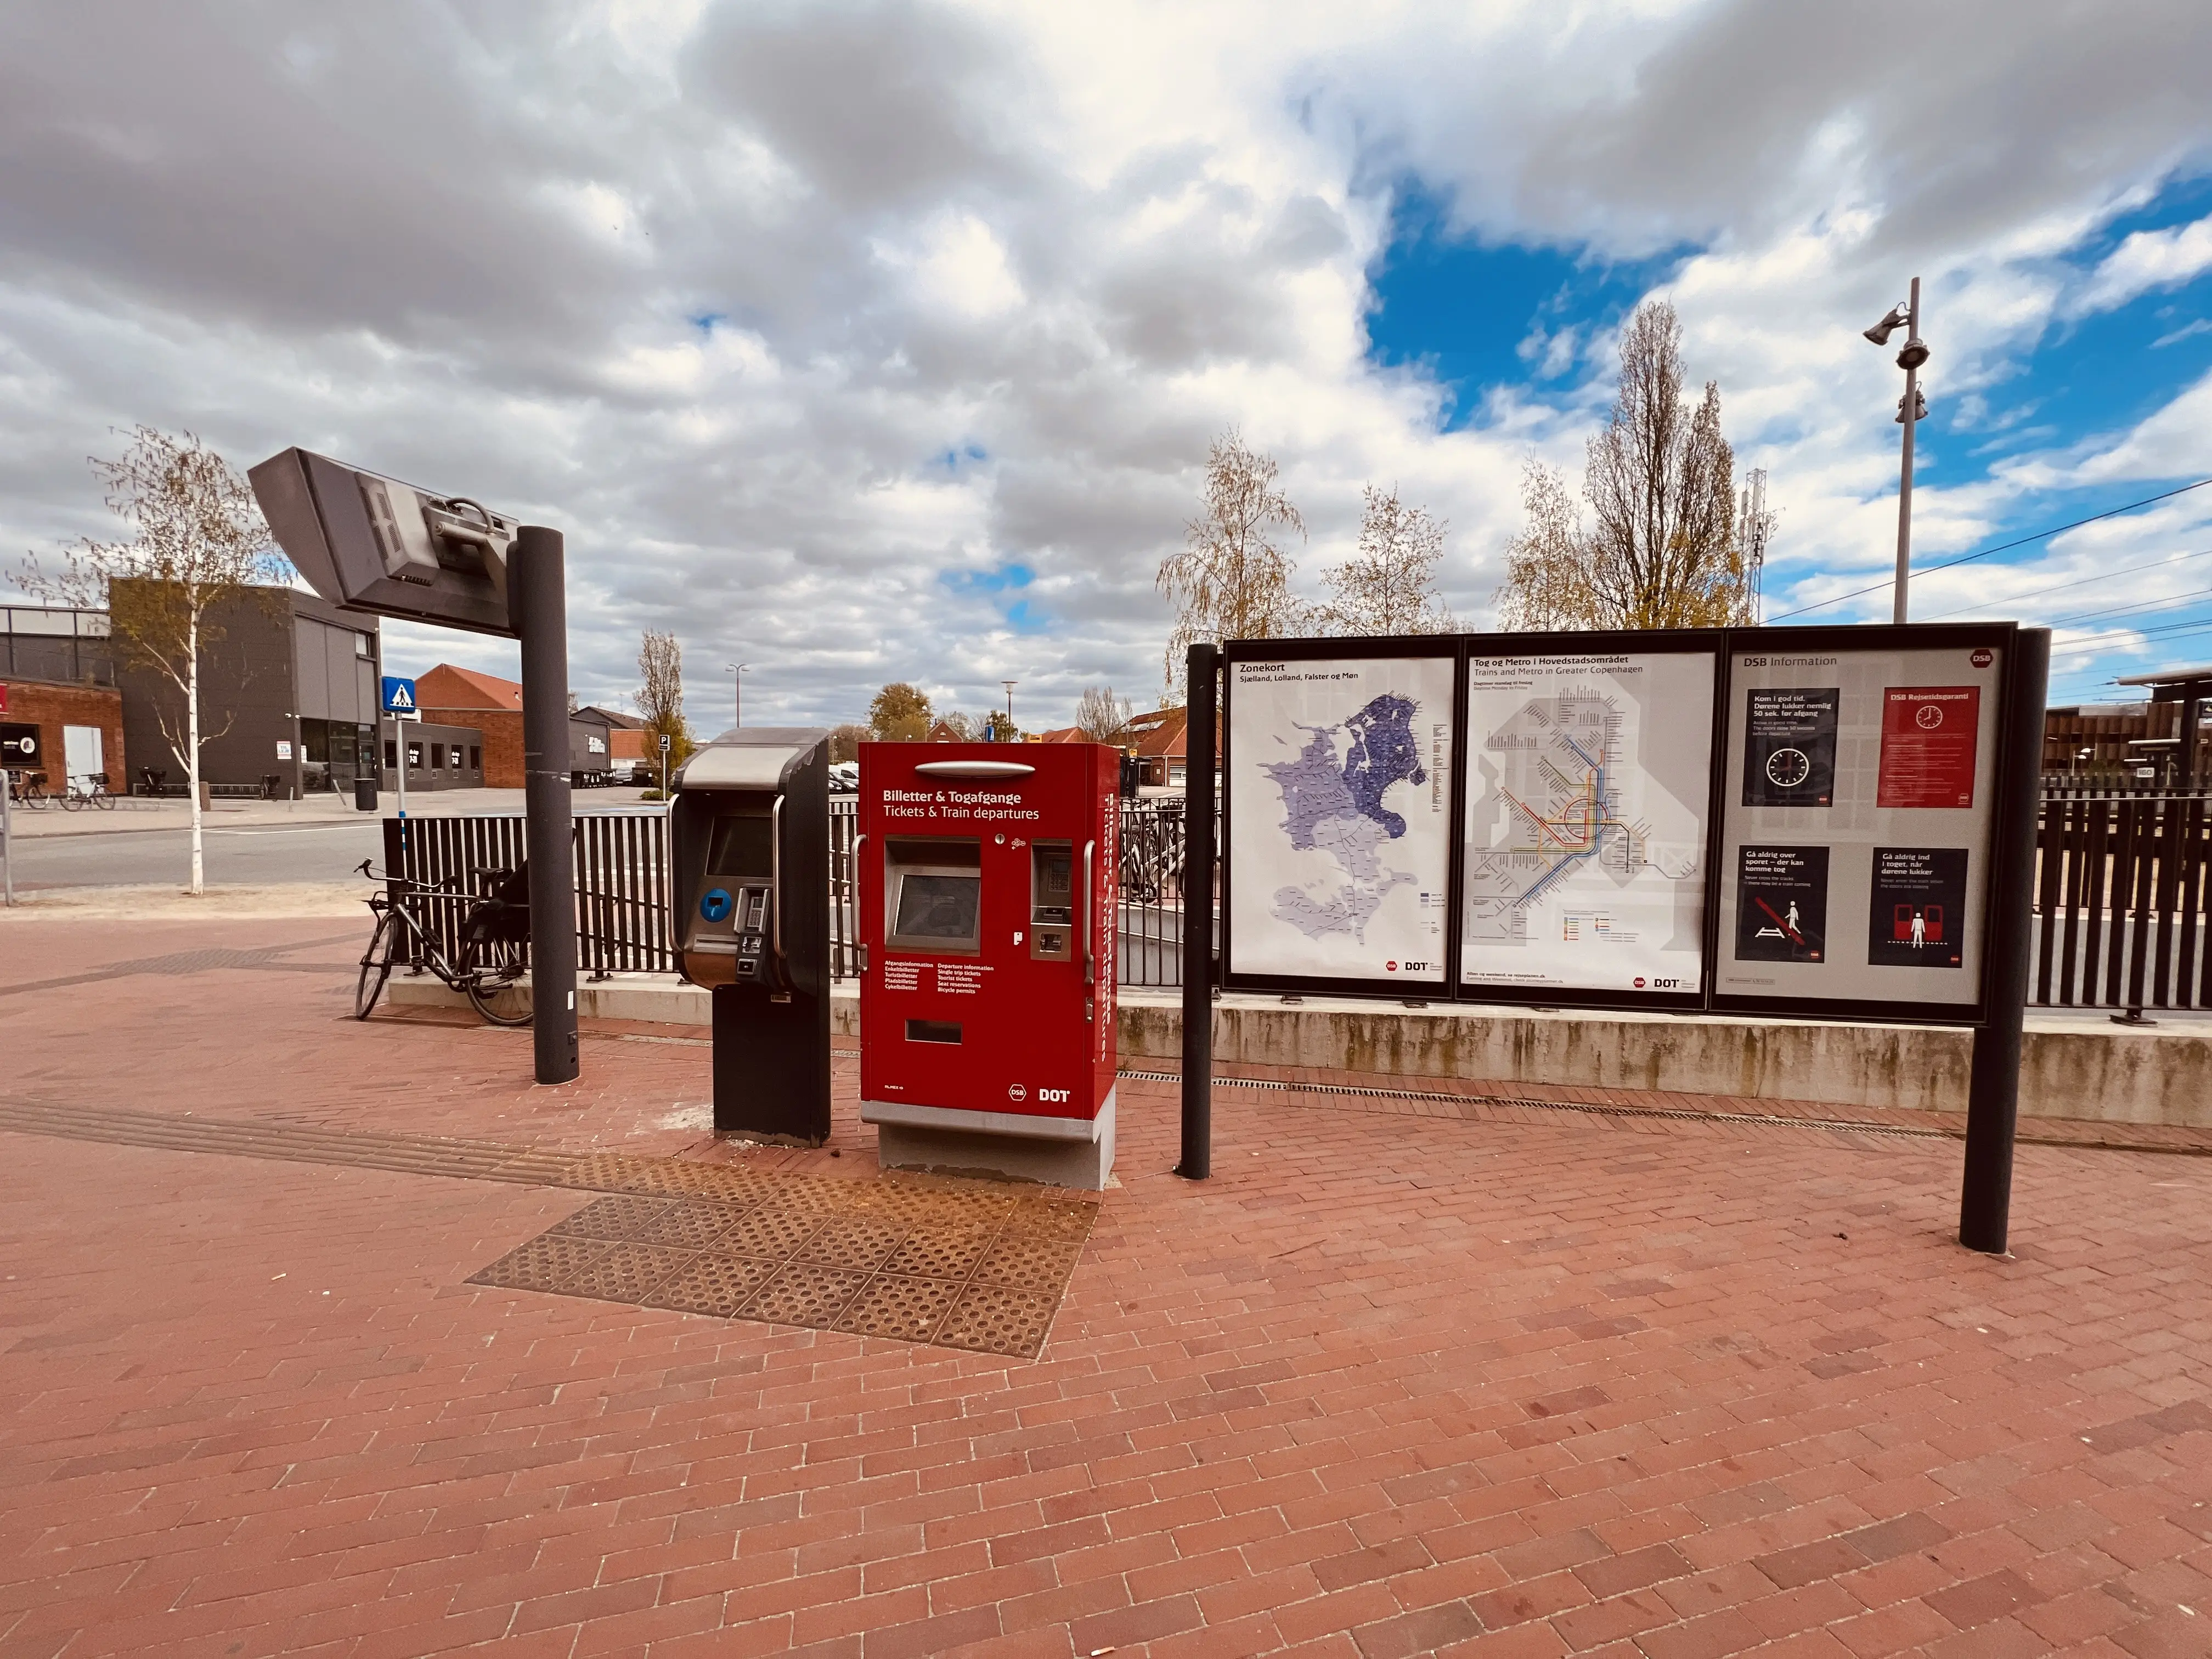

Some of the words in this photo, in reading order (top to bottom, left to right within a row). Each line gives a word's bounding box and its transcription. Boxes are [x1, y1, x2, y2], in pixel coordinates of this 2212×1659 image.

[1474, 659, 1489, 667] Tog
[1539, 656, 1628, 665] Hovedstadsområdet
[1744, 658, 1767, 667] DSB
[1770, 657, 1837, 666] Information
[1240, 663, 1285, 672] Zonekort
[1590, 666, 1643, 674] Copenhagen
[883, 790, 933, 802] Billetter
[935, 791, 945, 802] &
[948, 791, 1022, 805] Togafgange
[883, 805, 924, 817] Tickets
[928, 806, 937, 817] &
[940, 806, 970, 818] Train
[973, 807, 1039, 821] departures
[1405, 962, 1428, 970] DOT
[1654, 979, 1679, 988] DOT
[1039, 1088, 1070, 1103] DOT
